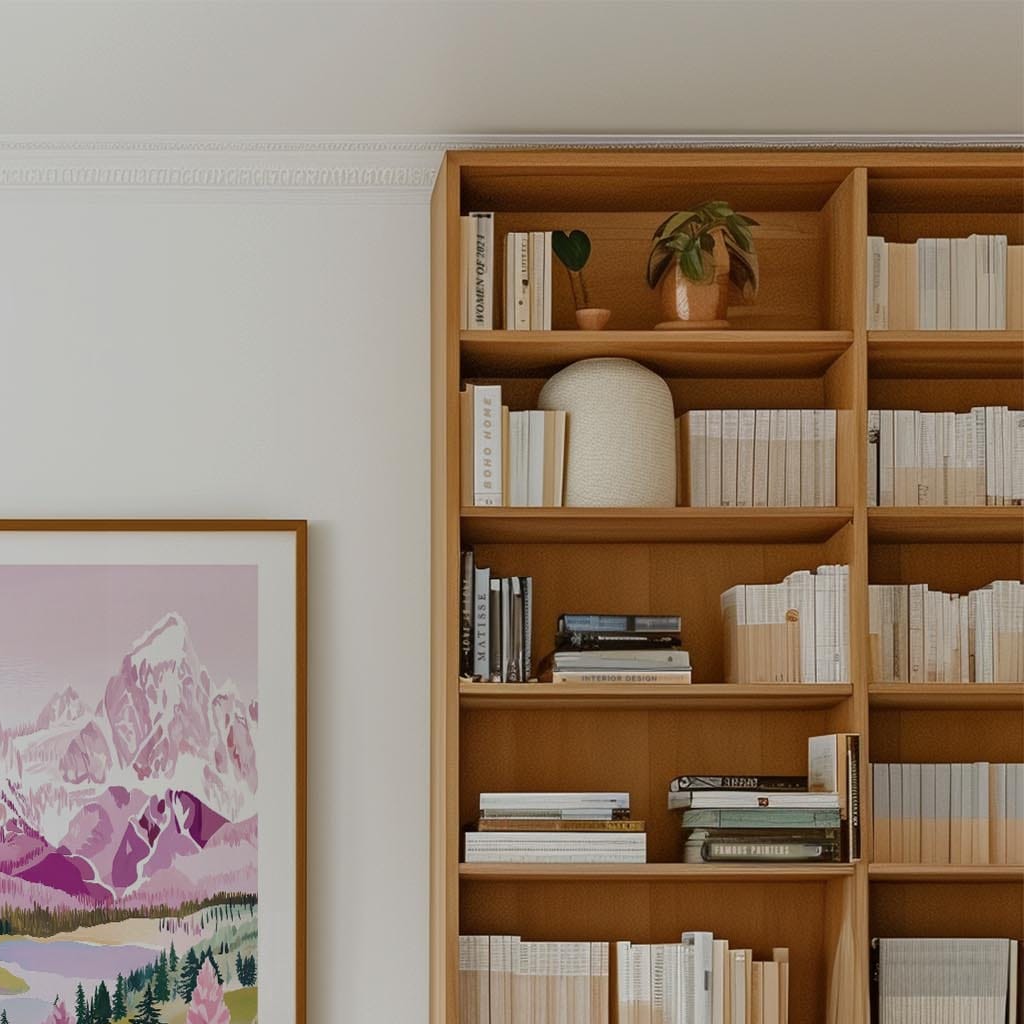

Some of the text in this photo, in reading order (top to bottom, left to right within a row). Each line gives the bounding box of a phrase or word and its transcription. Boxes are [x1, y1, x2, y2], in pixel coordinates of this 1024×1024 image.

[475, 234, 485, 323] WOMEN OF 2024
[483, 397, 492, 489] BOHO HOME
[477, 593, 486, 662] MATISSE
[714, 845, 789, 855] FAMOUS PAINTERS
